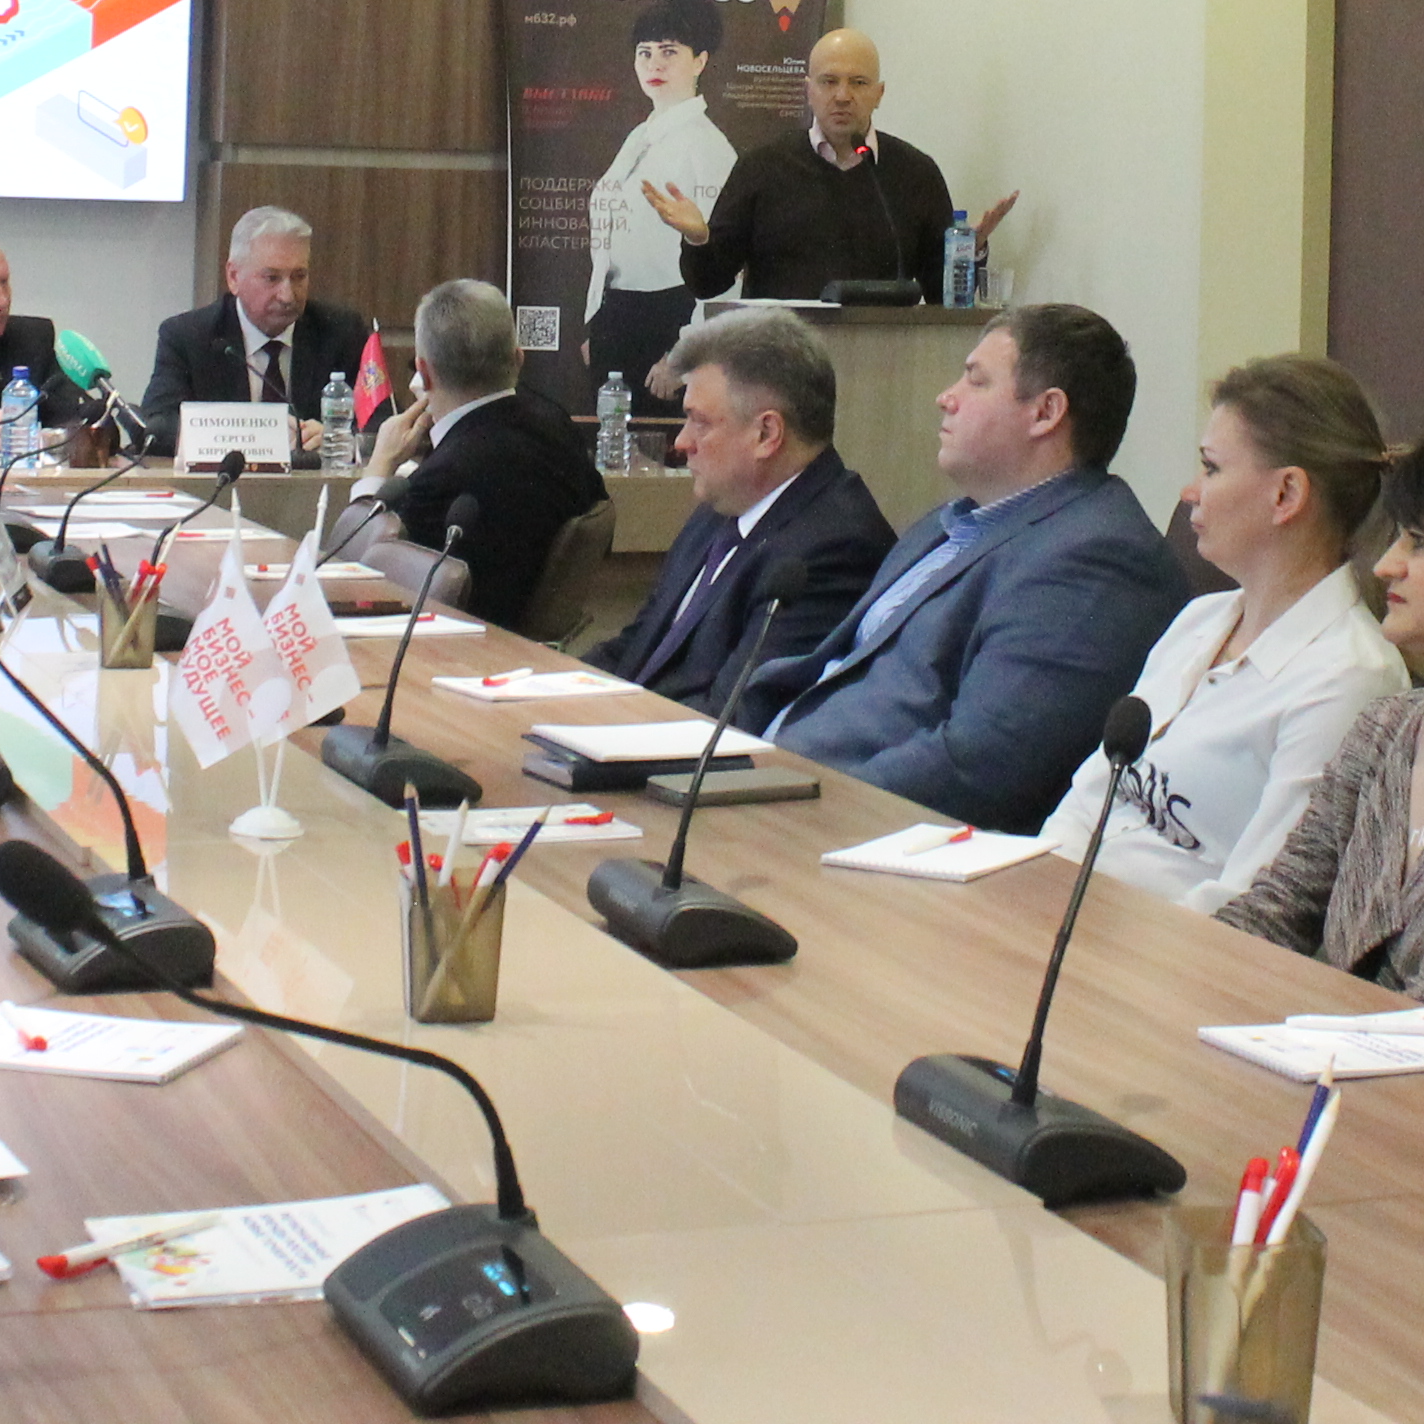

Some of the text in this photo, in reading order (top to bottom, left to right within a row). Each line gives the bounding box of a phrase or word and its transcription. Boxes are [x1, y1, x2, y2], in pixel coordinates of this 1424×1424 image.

[524, 10, 577, 27] мб32.рф
[519, 177, 623, 193] ПОДДЕРЖКА
[519, 197, 633, 213] СОЦБИЗНЕСА,
[519, 215, 631, 232] ИННОВАЦИЙ,
[518, 235, 612, 250] КЛАСТЕРОВ
[189, 417, 279, 429] СИМОНЕНКО
[214, 434, 256, 443] СЕРГЕЙ
[284, 602, 319, 654] МОЙ
[217, 617, 254, 670] МОЙ
[270, 611, 313, 691] БИЗНЕС
[190, 635, 221, 684] МОЕ
[202, 626, 252, 707] БИЗНЕС
